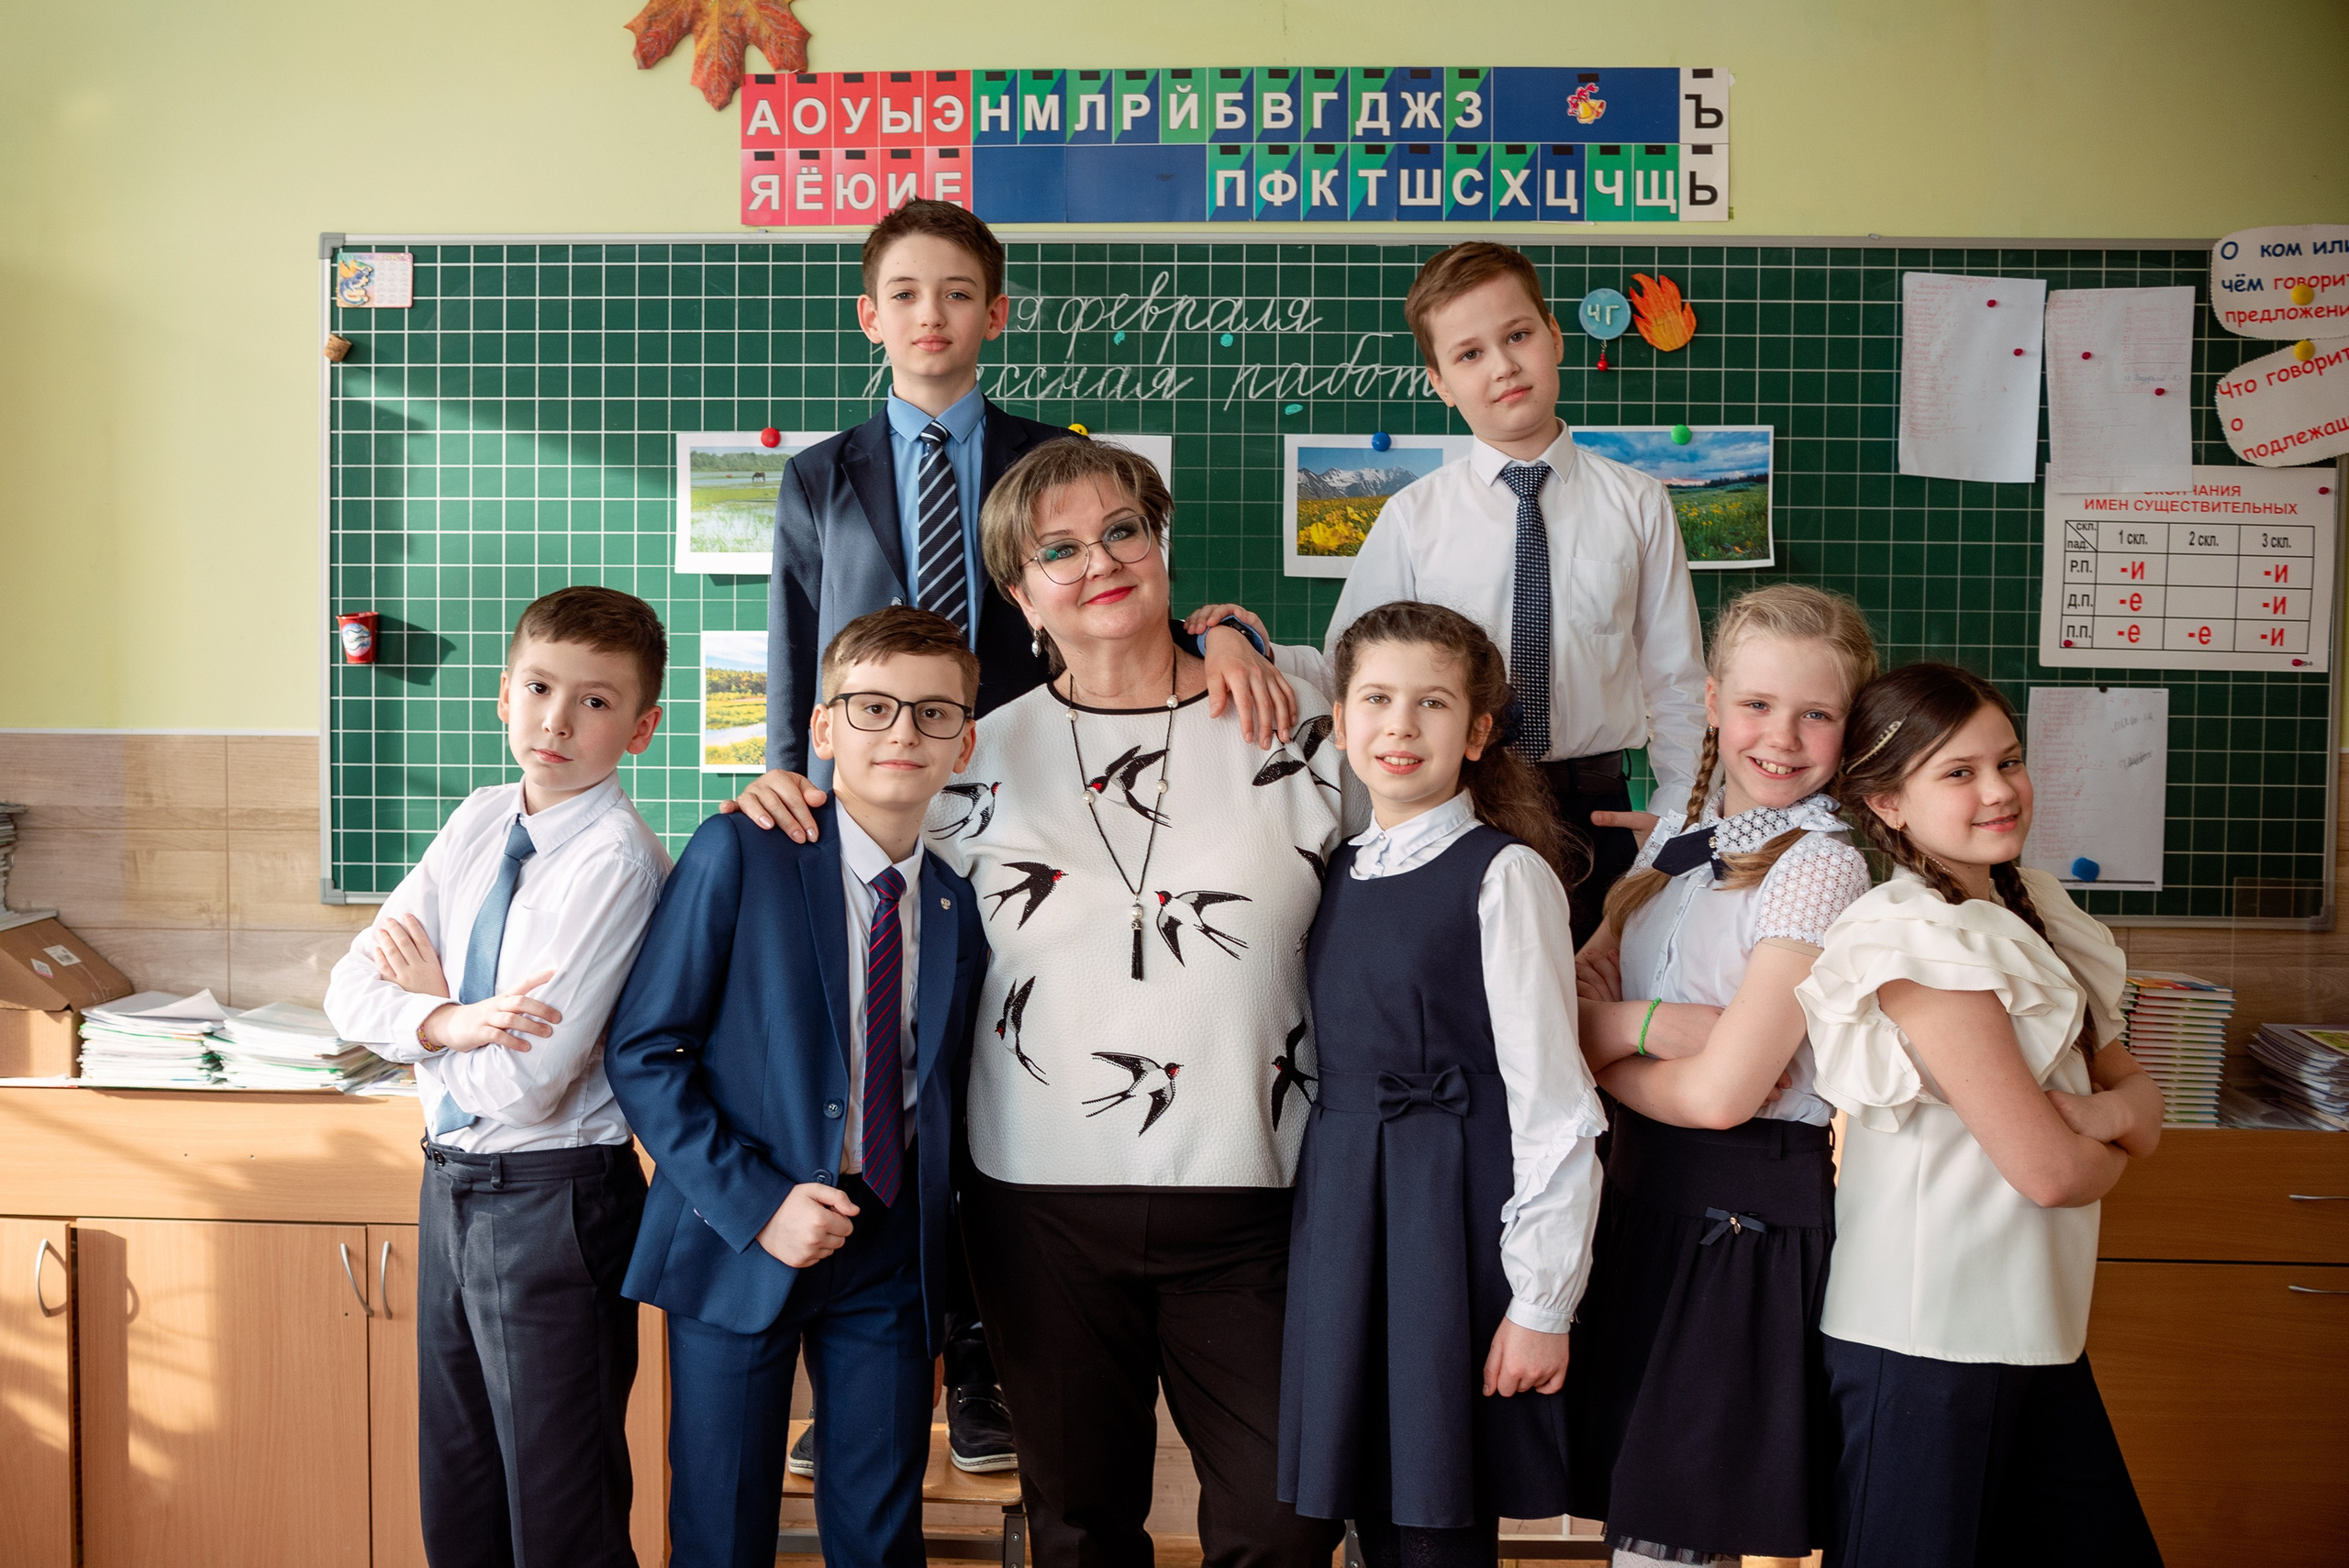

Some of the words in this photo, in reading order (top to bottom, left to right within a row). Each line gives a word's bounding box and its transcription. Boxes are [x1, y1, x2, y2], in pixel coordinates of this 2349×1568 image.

[747, 100, 781, 136] А
[793, 97, 827, 135] О
[841, 97, 871, 134] У
[882, 97, 922, 134] Ы
[933, 95, 964, 132] Э
[980, 95, 1010, 132] Н
[1023, 94, 1060, 131] М
[1074, 94, 1106, 131] Л
[1121, 94, 1151, 130] Р
[1168, 83, 1199, 130] Й
[1215, 92, 1247, 129] Б
[1262, 92, 1294, 128] В
[1312, 92, 1339, 128] Г
[1355, 92, 1391, 136] Д
[1400, 92, 1442, 128] Ж
[1454, 91, 1483, 128] З
[1685, 94, 1723, 129] Ъ
[748, 174, 780, 211] Я
[796, 166, 824, 210] Ё
[835, 172, 876, 210] Ю
[1216, 170, 1246, 206] П
[1258, 169, 1297, 206] Ф
[1311, 169, 1339, 206] К
[1357, 169, 1387, 206] Т
[1399, 169, 1442, 206] Ш
[1452, 168, 1484, 206] С
[1498, 169, 1531, 206] Х
[1546, 169, 1578, 214] Ц
[1595, 170, 1624, 206] Ч
[1635, 170, 1677, 215] Щ
[1689, 171, 1719, 206] Ь
[2221, 240, 2240, 261] О
[2260, 242, 2302, 258] ком
[2221, 273, 2264, 293] чём
[2274, 273, 2349, 293] говори
[1058, 271, 1324, 364] февраля
[1223, 333, 1438, 412] работ
[2218, 380, 2257, 399] Что
[2084, 498, 2129, 511] ИМЕН
[2133, 499, 2299, 516] СУЩЕСТВИТЕЛЬНЫХ
[2076, 522, 2098, 531] скл.
[2118, 529, 2124, 544] 1
[2127, 532, 2148, 545] скл.
[2188, 530, 2196, 546] 2
[2198, 534, 2219, 547] скл.
[2262, 532, 2269, 548] 3
[2271, 535, 2292, 549] скл.
